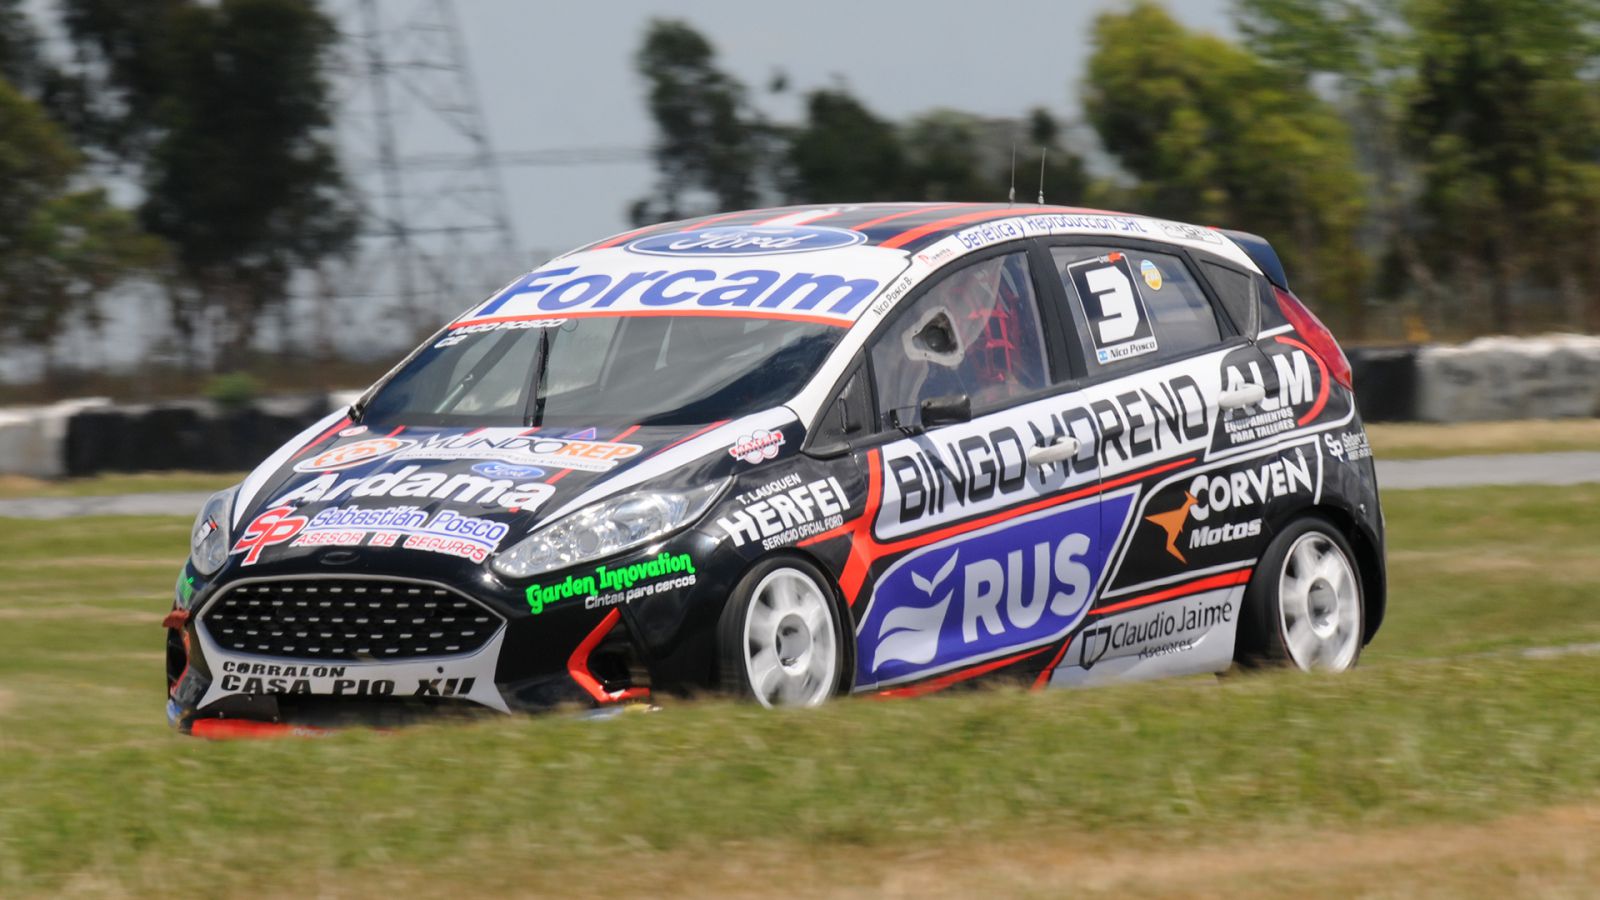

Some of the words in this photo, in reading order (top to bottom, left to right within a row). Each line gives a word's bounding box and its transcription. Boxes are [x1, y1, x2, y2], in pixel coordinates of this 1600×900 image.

[669, 226, 817, 251] Ford
[474, 266, 880, 318] Forcam
[1085, 265, 1140, 344] 3
[1224, 407, 1295, 433] EQUIPAMIENTOS
[1230, 429, 1256, 444] PARA
[889, 424, 1027, 525] BINGO
[1028, 375, 1210, 486] MORENO
[271, 466, 556, 512] Ardama
[736, 494, 750, 505] T.
[749, 473, 802, 501] LAUQUEN
[1192, 452, 1313, 522] CORVEN
[310, 506, 427, 528] Sebastián
[430, 510, 507, 541] Posco
[716, 476, 850, 547] HERFEI
[232, 508, 306, 565] SP
[295, 531, 363, 545] ASESOR
[372, 532, 398, 547] DE
[404, 535, 488, 562] SEGUROS
[762, 531, 799, 551] SERVICIO
[799, 522, 826, 538] OFICIAL
[824, 515, 844, 531] FORD
[1190, 518, 1262, 549] Motos
[525, 575, 598, 614] Garden
[595, 552, 696, 591] Innovation
[585, 591, 626, 609] Cintas
[626, 584, 654, 604] para
[655, 574, 696, 593] cercos
[962, 533, 1091, 644] RUS
[1111, 611, 1176, 649] Claudio
[1177, 602, 1232, 633] Jaime
[1137, 638, 1193, 660] Asesores
[220, 674, 314, 695] CASA
[332, 679, 396, 696] PIO
[413, 677, 476, 697] XII
